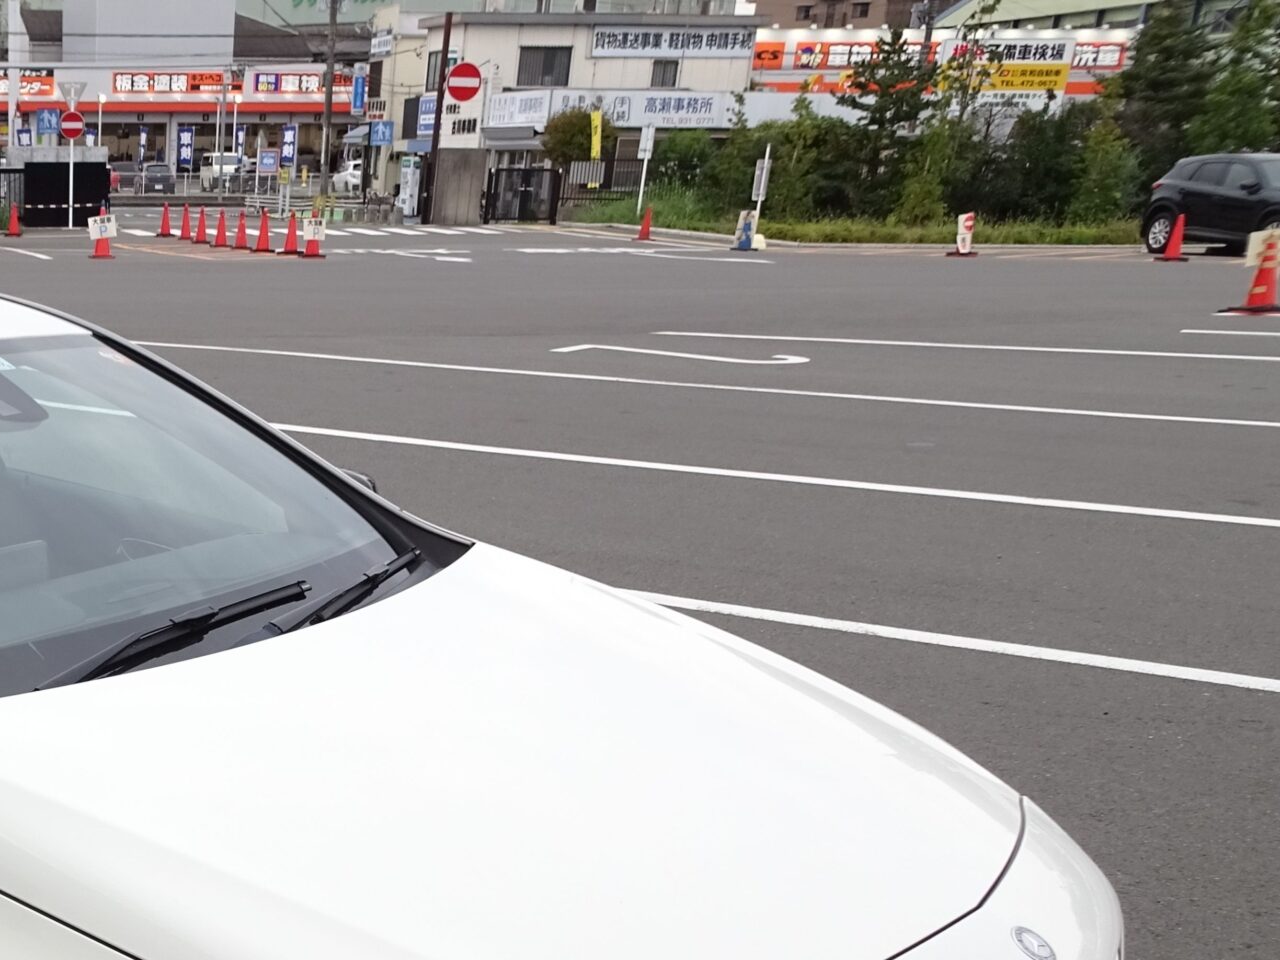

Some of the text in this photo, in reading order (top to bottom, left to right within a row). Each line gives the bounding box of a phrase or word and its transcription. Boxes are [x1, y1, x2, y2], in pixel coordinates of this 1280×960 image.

[595, 32, 703, 50] 貨物運送事業・軽貨物
[1073, 46, 1123, 66] 洗車
[115, 73, 188, 91] 板金・塗装
[281, 74, 320, 92] 車検
